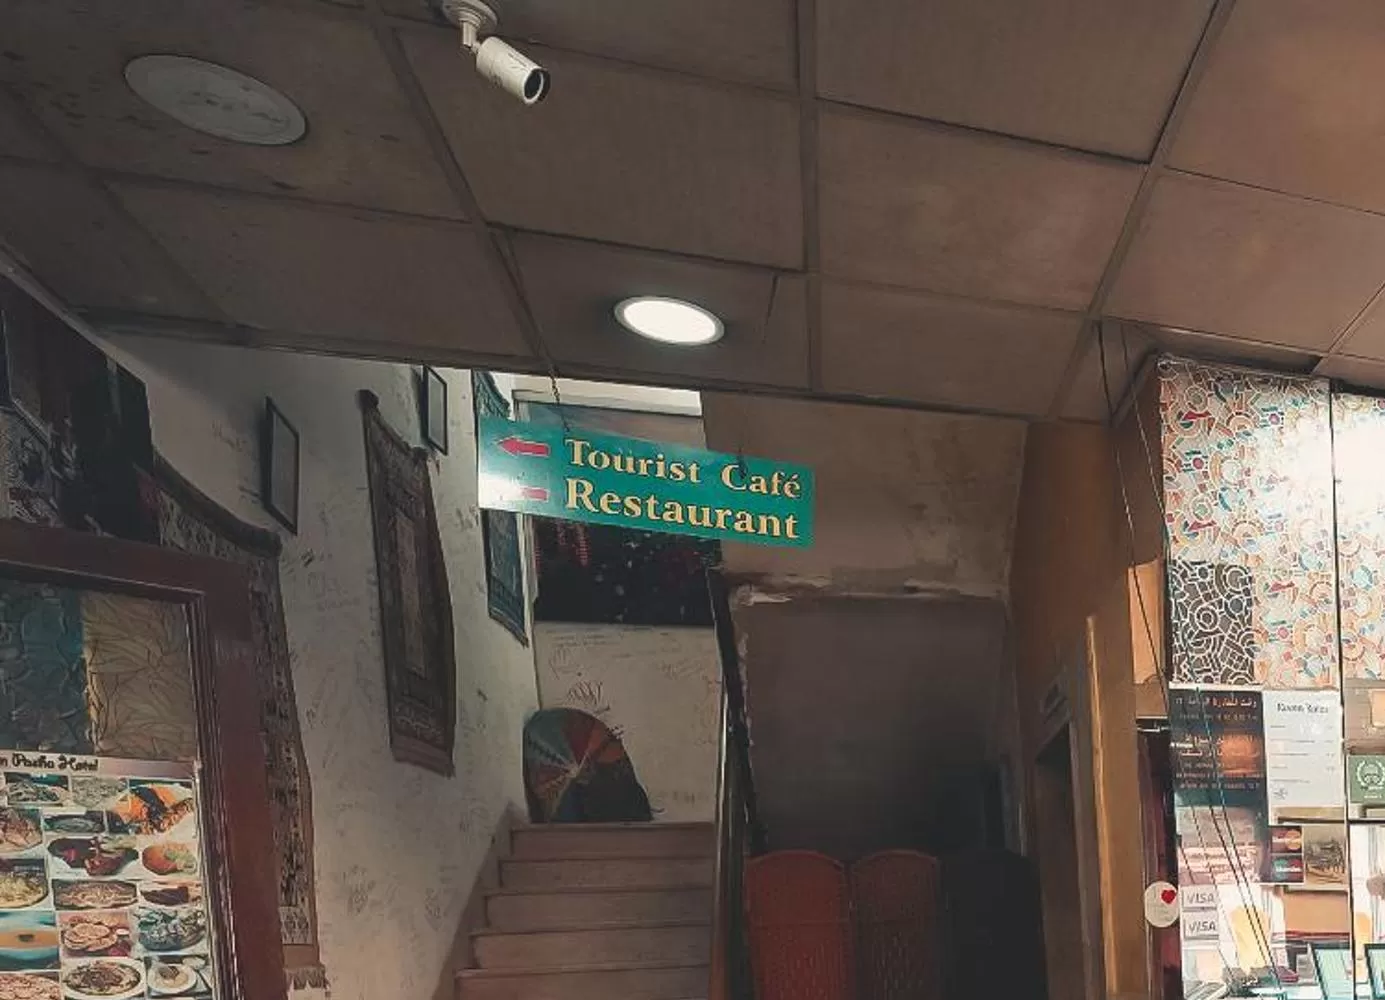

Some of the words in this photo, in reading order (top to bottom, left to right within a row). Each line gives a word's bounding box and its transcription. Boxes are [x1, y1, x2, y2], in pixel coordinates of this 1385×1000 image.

[565, 438, 702, 484] Tourist
[720, 463, 801, 498] Café
[565, 477, 800, 539] Restaurant
[1186, 893, 1215, 905] VISA
[1188, 921, 1217, 932] VISA
